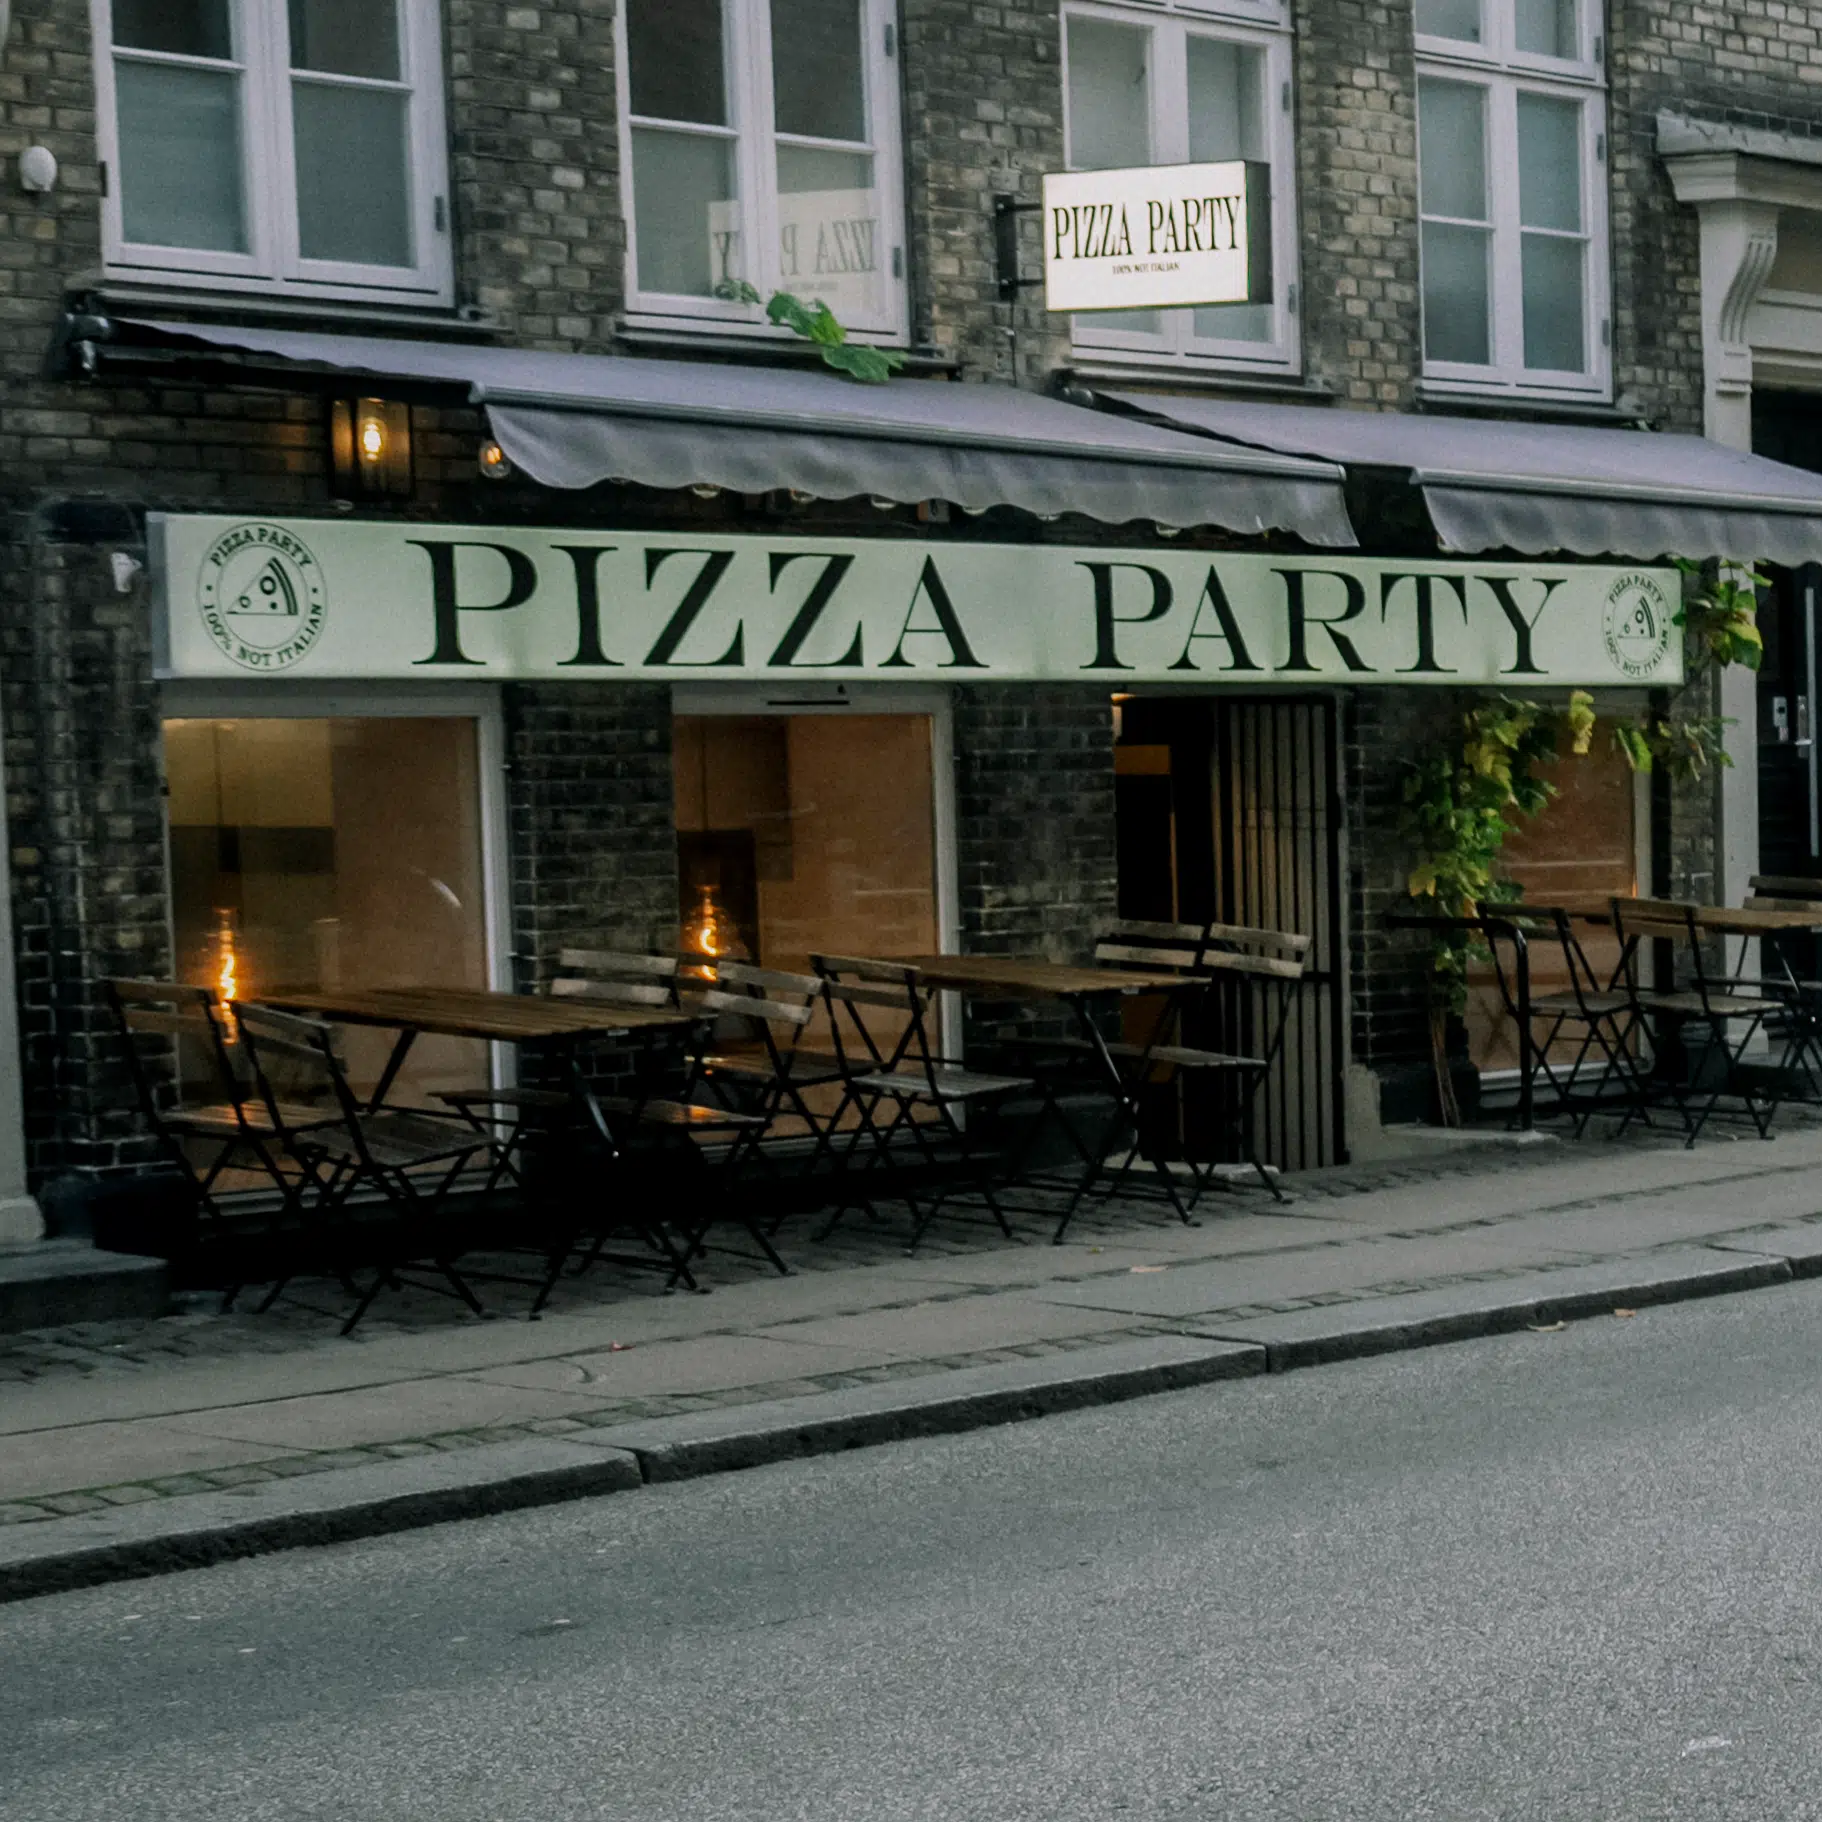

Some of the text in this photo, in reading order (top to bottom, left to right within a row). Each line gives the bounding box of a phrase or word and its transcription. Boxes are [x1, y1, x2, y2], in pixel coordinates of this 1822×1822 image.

[1053, 196, 1241, 260] PIZZA PARTY
[210, 527, 312, 568] PIZZA PARTY
[237, 646, 271, 666] NOT
[277, 603, 322, 664] ITALIAN
[405, 539, 1568, 674] PIZZA PARTY
